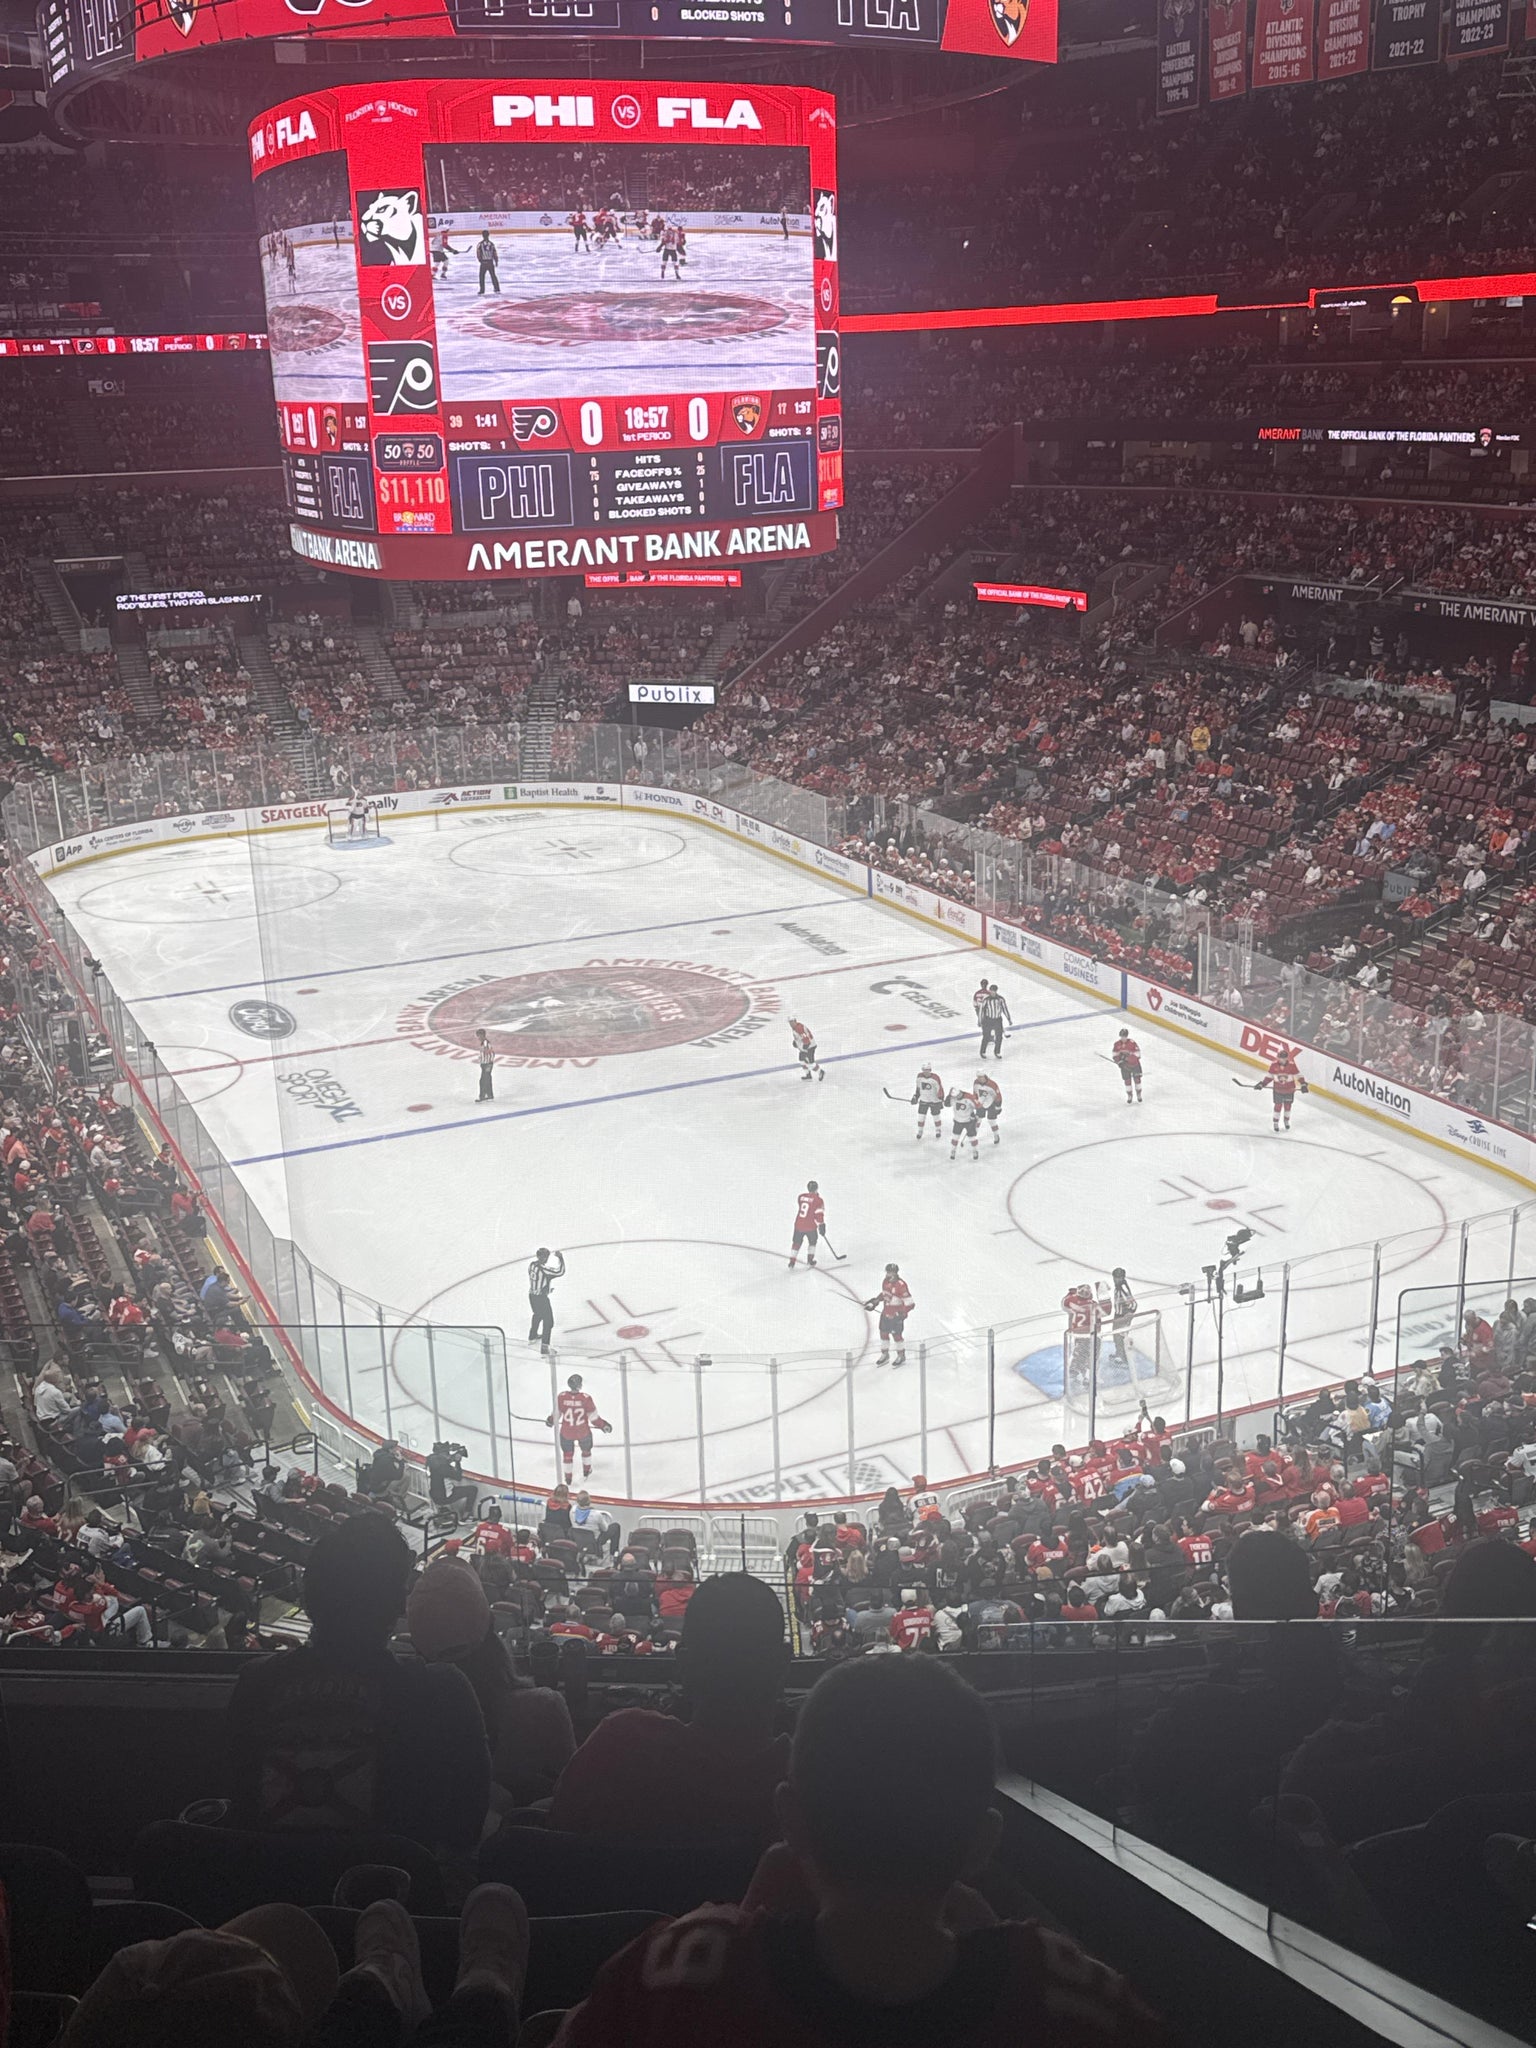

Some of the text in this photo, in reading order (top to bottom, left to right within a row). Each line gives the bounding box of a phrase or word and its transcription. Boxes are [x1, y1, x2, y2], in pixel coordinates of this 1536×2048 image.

[681, 9, 765, 22] BLOCKED SHOTS
[1329, 0, 1361, 18] ATLANTIC
[1393, 5, 1426, 22] TROPHY
[1456, 4, 1502, 27] CHAMPIONS
[1265, 16, 1304, 35] ATLANTIC
[1329, 14, 1359, 35] DIVISION
[1460, 24, 1494, 44] 2022-23
[1266, 32, 1302, 49] DIVISION
[1324, 30, 1363, 53] CHAMPIONS
[1389, 39, 1425, 58] 2021-22
[1260, 47, 1307, 65] CHAMPIONS
[1329, 50, 1356, 69] 2021-22
[1268, 64, 1300, 80] 2015-16
[345, 100, 418, 122] FLORIDA HOCKEY
[492, 95, 762, 130] PHI VS FLA
[276, 110, 317, 150] FLA
[760, 215, 800, 227] AutoNtion
[387, 296, 406, 310] VS
[107, 338, 116, 353] 0
[130, 338, 159, 352] 18:57
[206, 336, 215, 350] 0
[777, 401, 812, 415] 17 1:57
[449, 414, 497, 428] 39 1:41
[580, 401, 603, 446] 0
[625, 406, 668, 430] 18:57
[688, 397, 709, 441] 0
[623, 431, 672, 442] 1st PERIOD
[805, 427, 812, 436] 2
[1258, 428, 1475, 443] AMERANT BANK THE OFFICIAL BANK OF THE FLORIDA PANTHERS
[384, 444, 434, 459] 50 50
[635, 454, 661, 465] HITS
[614, 468, 672, 479] FACEOFFS
[733, 452, 796, 506] FLA
[328, 465, 364, 519] FLA
[379, 476, 446, 507] $11,110
[478, 464, 555, 520] PHI
[616, 480, 682, 492] GIVEAWAYS
[615, 493, 685, 505] TAKEAWAYS
[608, 507, 657, 519] BLOCKED
[658, 506, 692, 516] SHOTS
[307, 532, 380, 570] BANK ARENA
[466, 522, 812, 571] AMERANT BANK ARENA
[657, 574, 669, 582] THE
[669, 574, 694, 582] FLORIDA
[694, 574, 724, 582] PANTHERS
[116, 594, 128, 603] OF
[129, 593, 147, 602] THE
[148, 592, 171, 601] FIRST
[168, 599, 189, 608] TWO
[189, 598, 207, 606] FOR
[208, 596, 248, 605] SLASHING
[1291, 585, 1343, 601] AMERANT
[1440, 601, 1460, 617] THE
[1463, 603, 1528, 626] AMERANT
[637, 685, 701, 703] Publix
[520, 786, 578, 798] Baptist Health
[644, 792, 683, 806] HONDA
[261, 803, 328, 823] SEATGEEK
[1063, 951, 1098, 972] COMCAST
[1063, 962, 1098, 984] BUSINESS
[584, 958, 782, 1048] AMERANT BANK ARENA
[901, 990, 961, 1019] CELSIUS
[396, 974, 599, 1069] AMEANT BANK ARENA
[1187, 1014, 1208, 1029] Hospital
[277, 1072, 326, 1106] SPORT
[304, 1068, 351, 1106] OMEGA
[1333, 1066, 1411, 1113] AutoNation
[314, 1101, 364, 1124] XL
[1446, 1124, 1507, 1158] Disney CRUISE LINE
[563, 1407, 585, 1427] 42
[1084, 1478, 1107, 1500] 42
